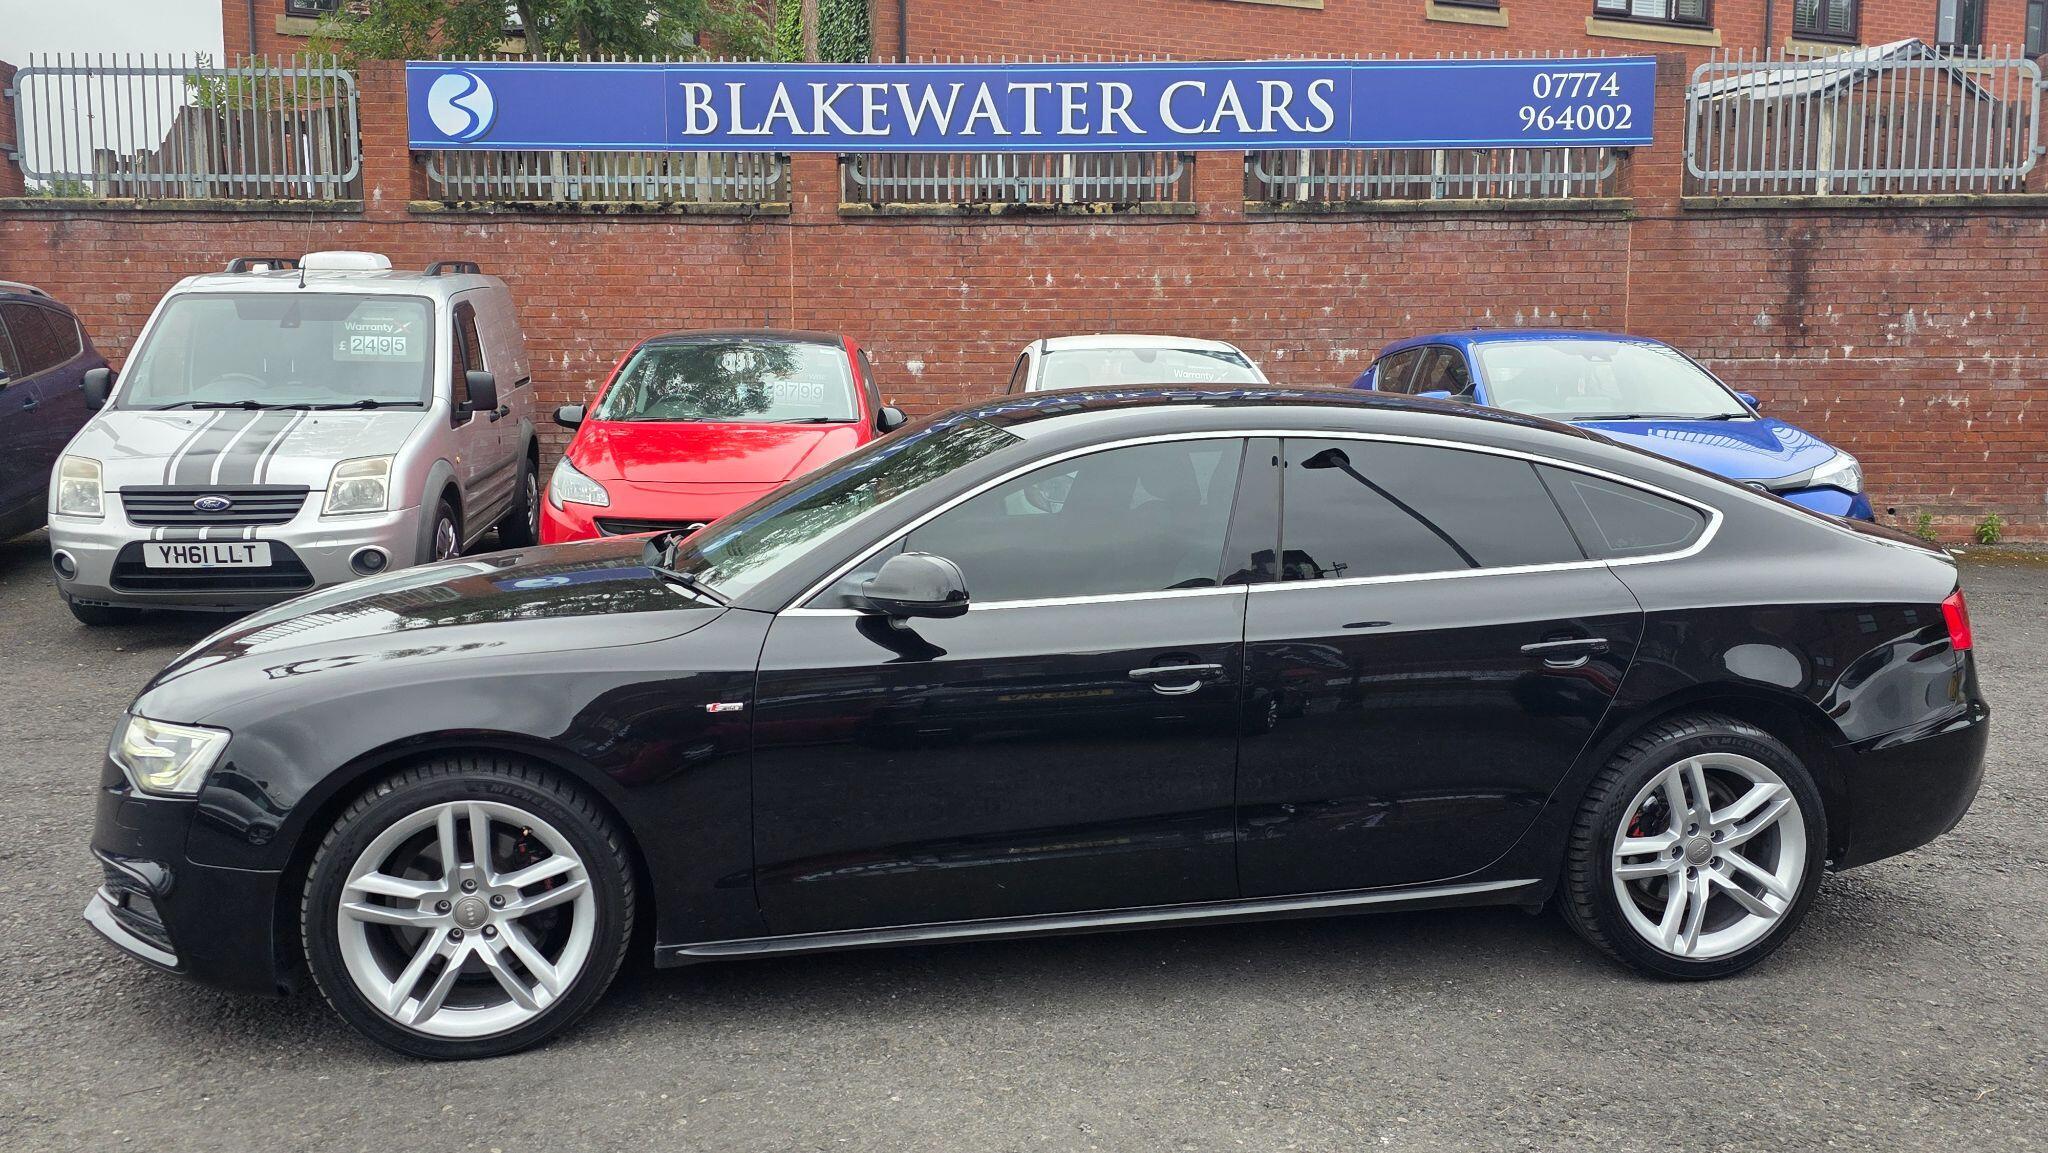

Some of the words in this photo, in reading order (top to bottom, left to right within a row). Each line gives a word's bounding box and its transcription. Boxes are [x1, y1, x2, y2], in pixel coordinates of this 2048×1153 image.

[1532, 72, 1620, 99] 07774
[680, 81, 1148, 136] BLAKEWATER
[1159, 78, 1335, 134] CARS
[1519, 103, 1633, 133] 964002
[344, 321, 394, 333] Warranty
[351, 337, 406, 354] 2495
[1173, 368, 1215, 381] Warranty
[158, 545, 209, 564] YH61
[213, 544, 257, 564] LLT
